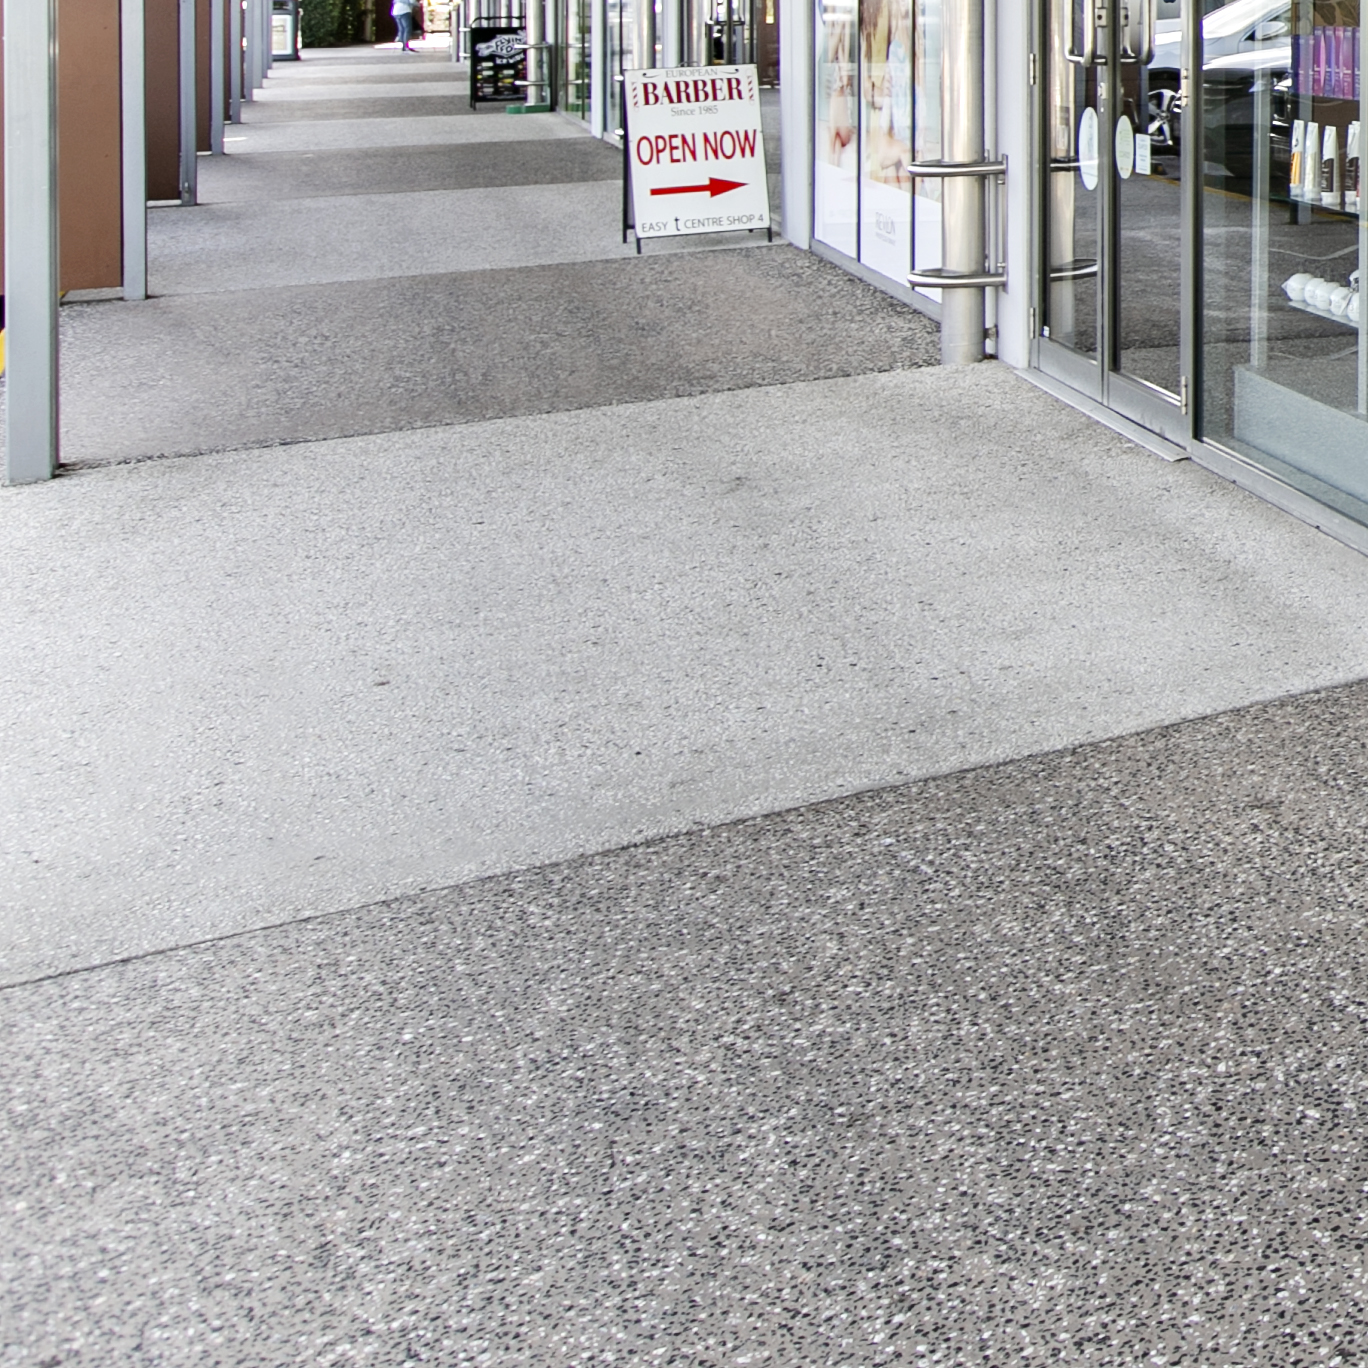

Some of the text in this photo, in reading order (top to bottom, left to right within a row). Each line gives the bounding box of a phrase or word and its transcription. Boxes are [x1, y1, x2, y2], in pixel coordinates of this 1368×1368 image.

[495, 37, 523, 51] FLYIN
[665, 68, 718, 78] EUROPEAN
[641, 77, 743, 106] BARBER
[671, 105, 719, 116] Since 1985
[636, 129, 757, 166] OPEN NOW
[641, 214, 764, 232] EASY t CENTRE SHOP 4
